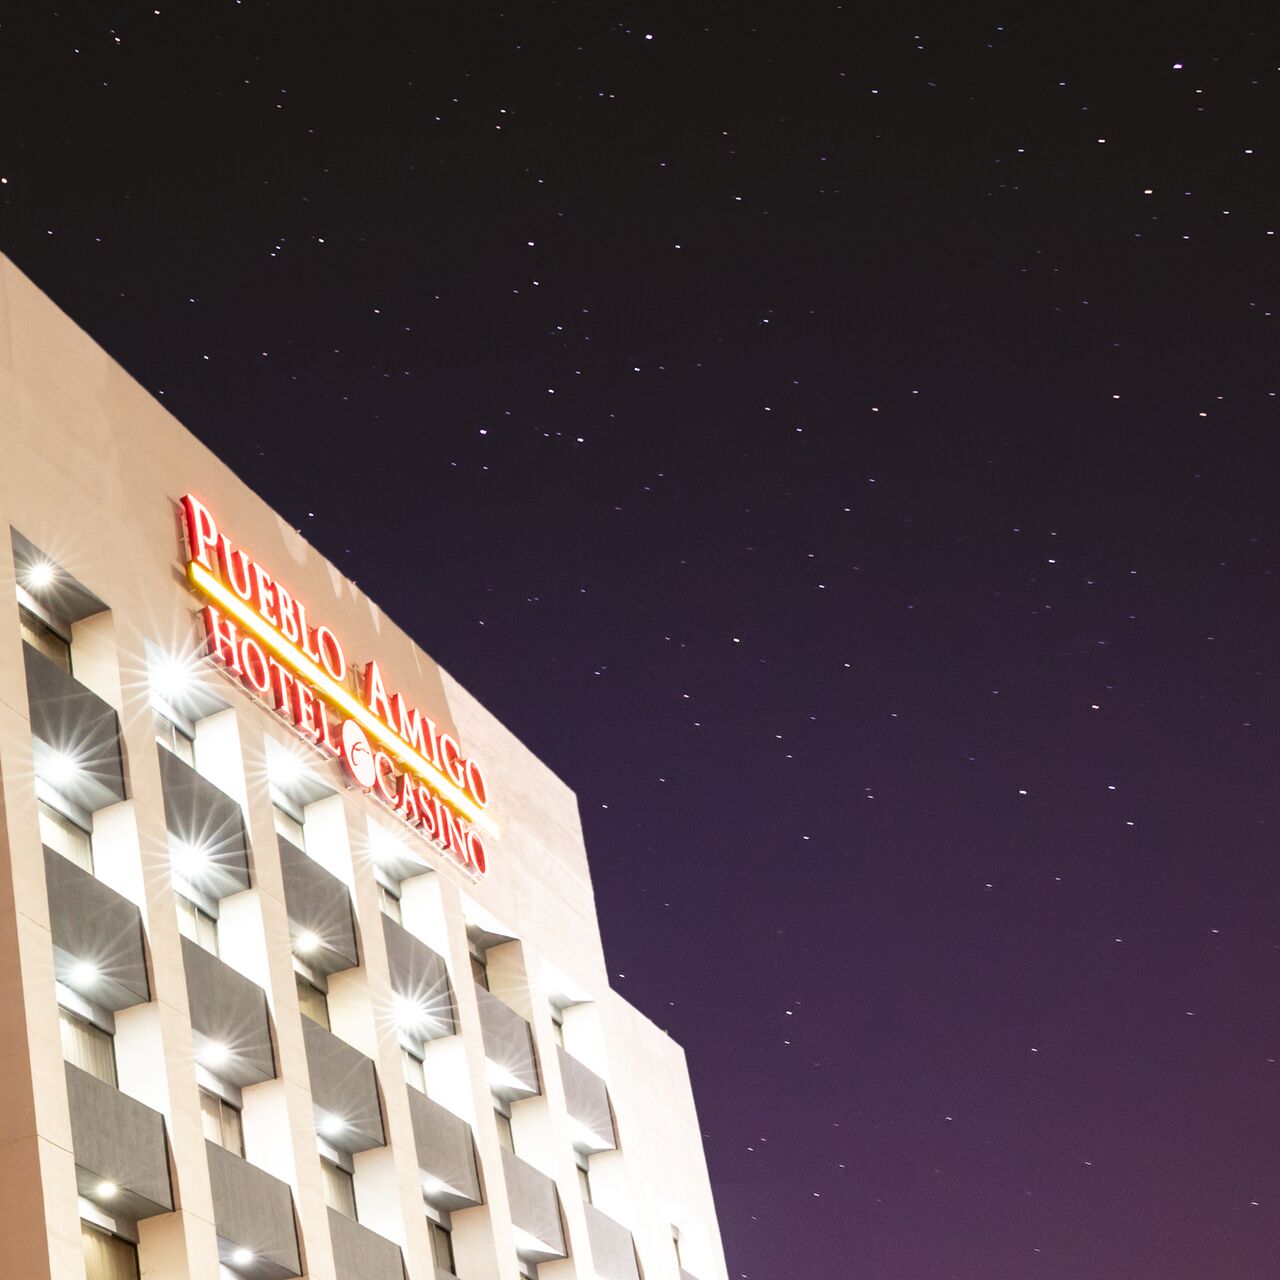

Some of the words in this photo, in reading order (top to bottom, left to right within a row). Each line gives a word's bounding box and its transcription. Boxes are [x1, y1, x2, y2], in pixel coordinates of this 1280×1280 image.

[179, 494, 347, 682] PUEBLO
[365, 661, 489, 808] AMIGO
[202, 604, 341, 756] HOTEL
[375, 751, 488, 877] CASINO
